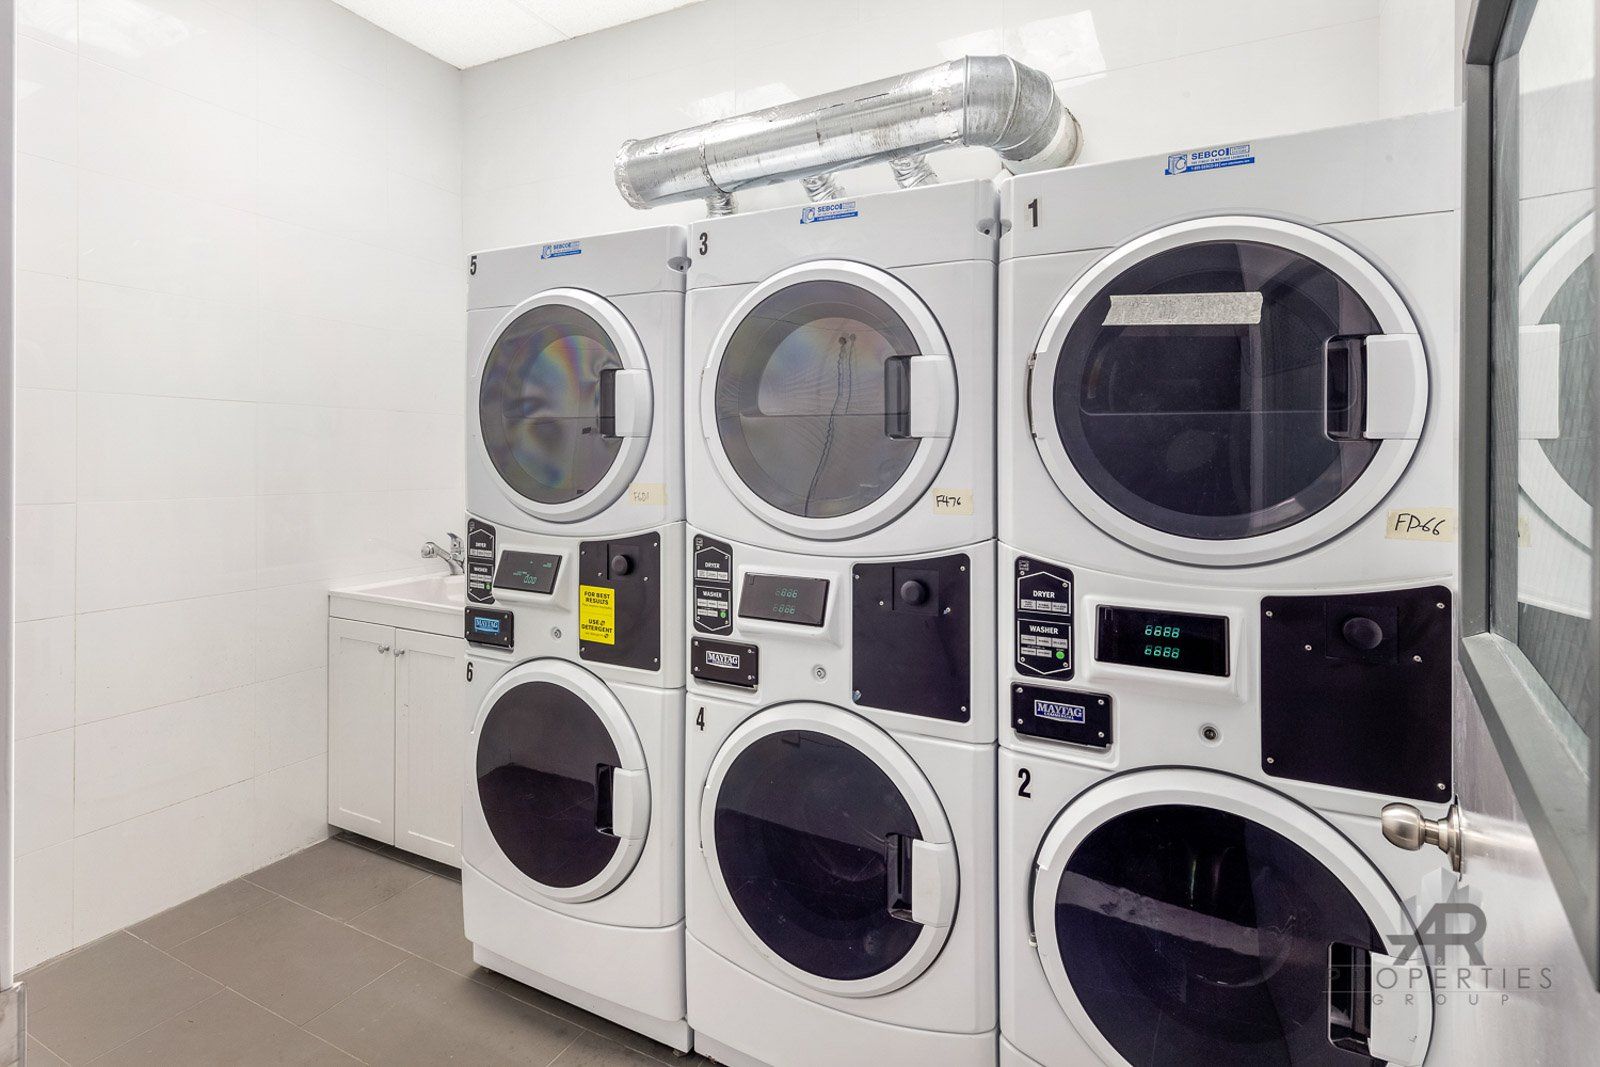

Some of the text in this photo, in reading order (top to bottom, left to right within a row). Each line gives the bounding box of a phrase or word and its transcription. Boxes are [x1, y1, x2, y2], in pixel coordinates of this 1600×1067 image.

[1191, 148, 1225, 160] SEBCO
[817, 203, 840, 213] SEBCO
[1028, 198, 1038, 227] 1
[699, 232, 708, 256] 3
[470, 255, 477, 276] 5
[702, 591, 722, 599] WASHER
[1032, 590, 1055, 598] DRYER
[585, 597, 609, 605] RESULTS
[475, 618, 498, 628] MAYTAG
[581, 624, 613, 633] DETERGENT
[1029, 625, 1058, 634] WASHER
[708, 652, 738, 664] MAYTAG
[466, 661, 474, 682] 6
[1037, 702, 1083, 718] MAYTAG
[696, 706, 705, 731] 4
[1018, 768, 1031, 798] 2
